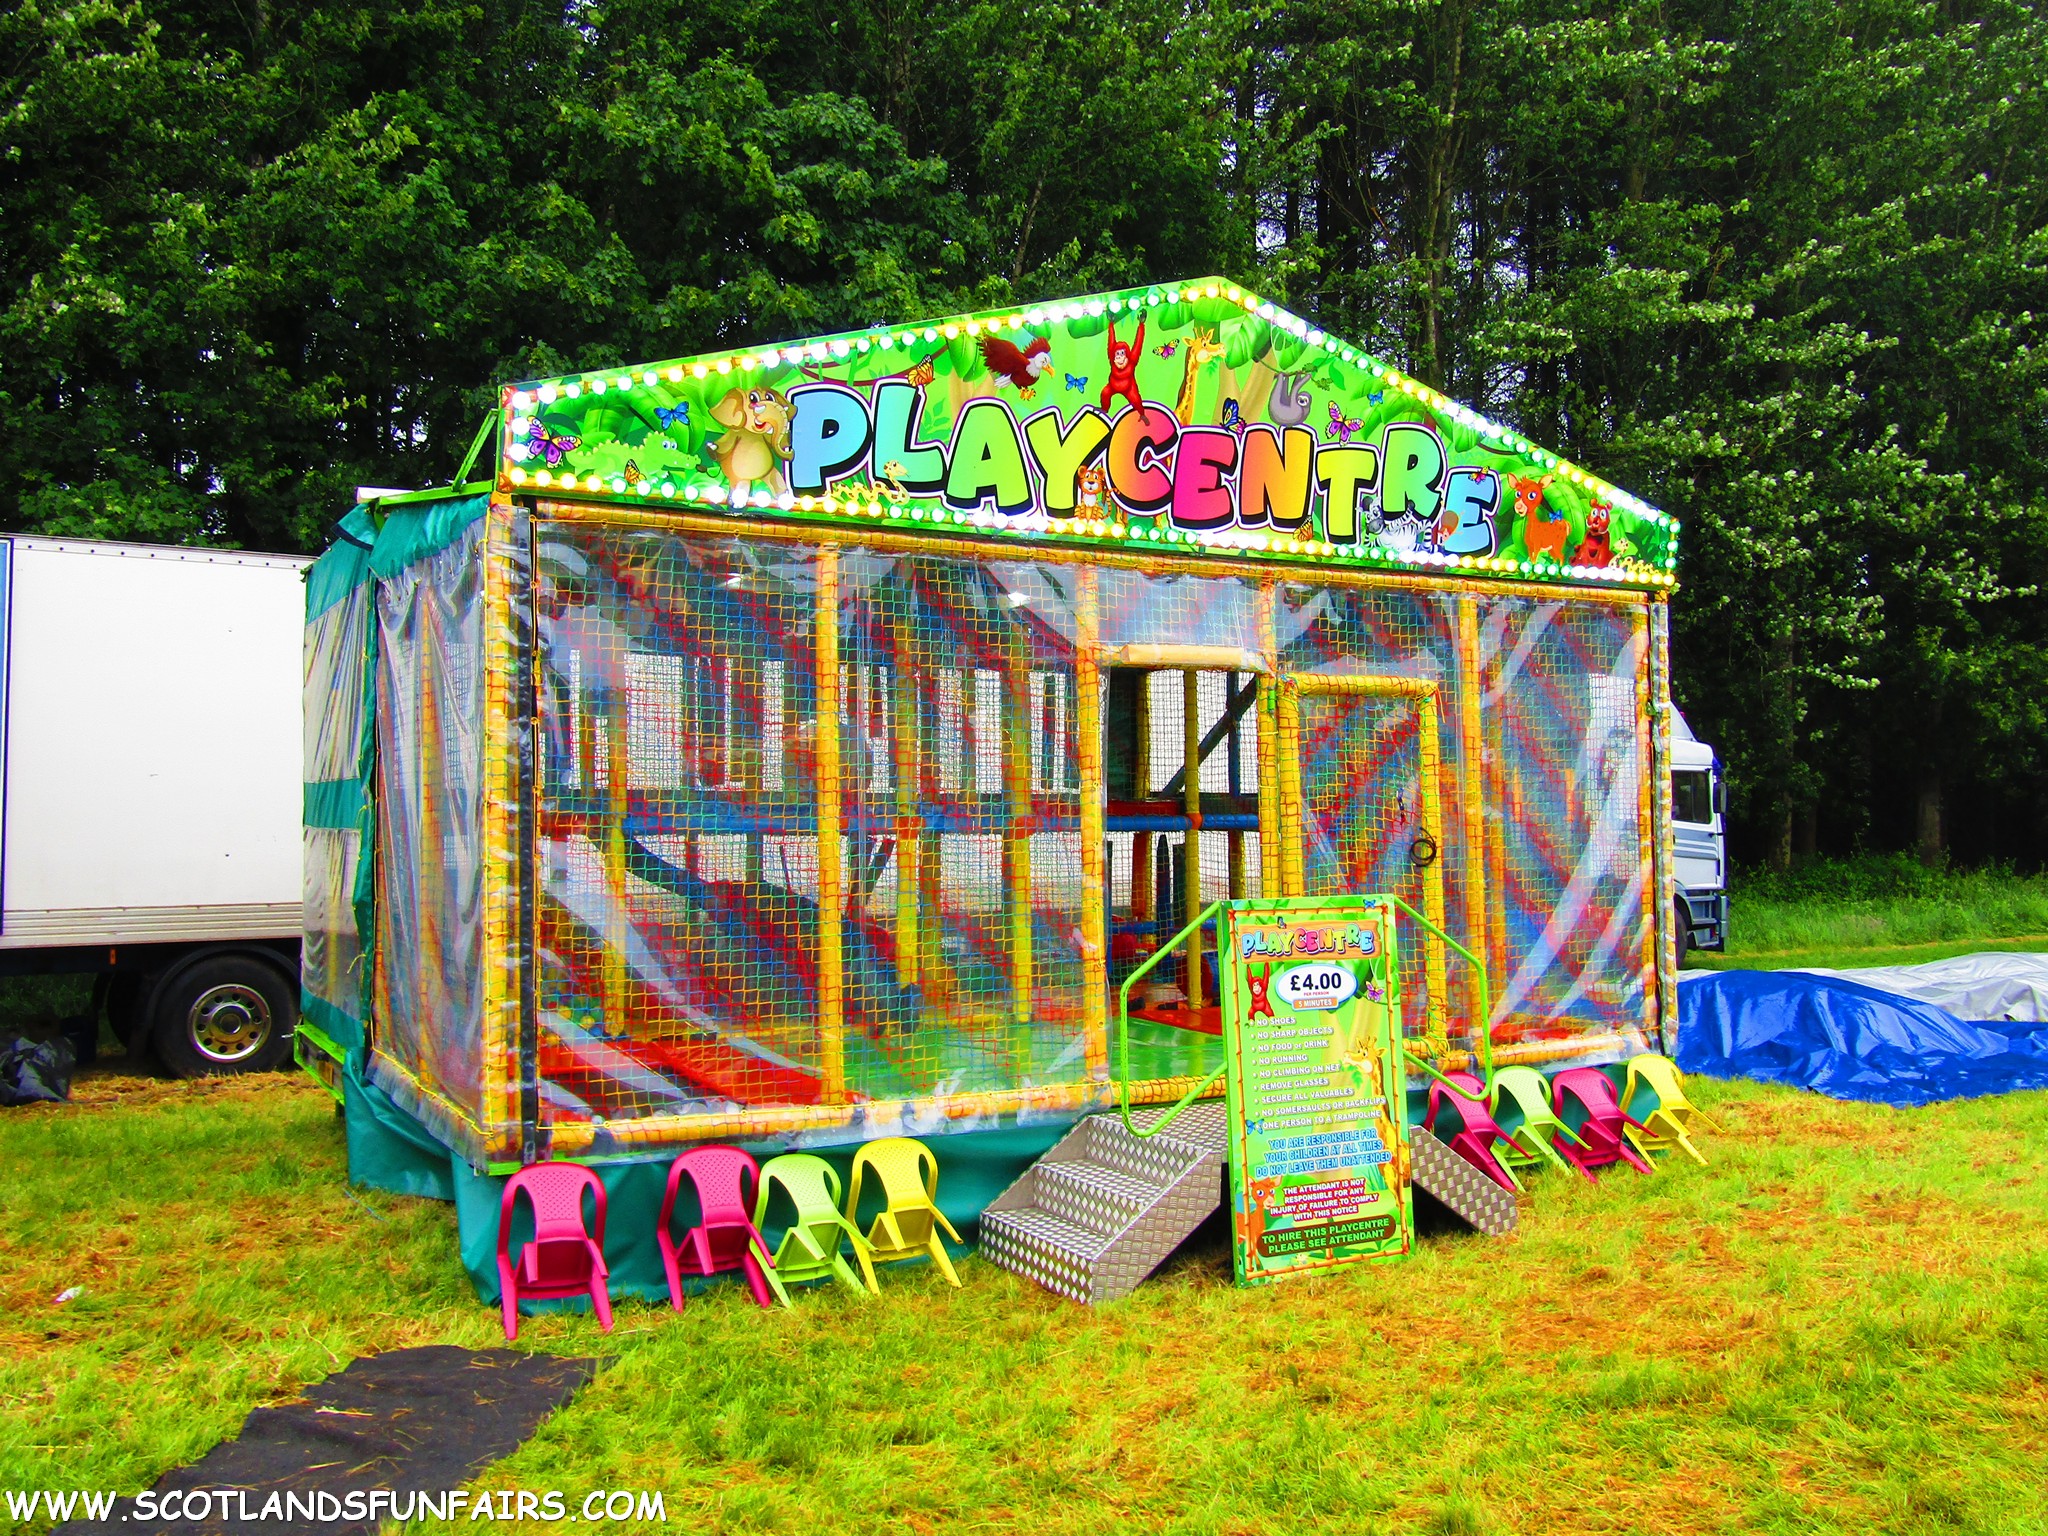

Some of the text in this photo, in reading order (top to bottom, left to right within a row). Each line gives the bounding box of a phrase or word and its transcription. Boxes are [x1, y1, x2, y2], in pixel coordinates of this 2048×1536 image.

[788, 380, 1499, 558] PLAYCENTRE
[1241, 923, 1374, 958] PLAYCENTRE
[1290, 972, 1341, 991] £4.00
[1304, 998, 1332, 1007] MINUTES
[1271, 1017, 1296, 1025] SHOES
[1271, 1030, 1296, 1038] SHARP
[1298, 1027, 1333, 1035] OBJECTS
[1304, 1040, 1329, 1048] DRINK
[1273, 1054, 1308, 1063] RUNNING
[1273, 1067, 1311, 1076] CLIMBING
[1261, 1078, 1329, 1091] REMOVE GLASSES
[1262, 1094, 1292, 1104] SECURE
[1311, 1088, 1353, 1098] VALUABLES
[1276, 1103, 1331, 1114] SOMERSAULTS
[1346, 1097, 1386, 1107] BACKFLIPS
[1263, 1121, 1279, 1129] ONE
[1282, 1118, 1312, 1127] PERSON
[1334, 1111, 1381, 1121] TRAMPOLINE
[1269, 1129, 1376, 1149] YOU ARE RESPONSIBLE FOR
[1264, 1140, 1382, 1163] YOUR CHILDREN AT ALL TIMES
[1256, 1152, 1391, 1177] DO NOT LEAVE THEM UNATTENDED
[1284, 1187, 1298, 1195] THE
[1299, 1182, 1340, 1193] ATTENDANT
[1285, 1191, 1332, 1204] RESPONSIBLE
[1350, 1187, 1364, 1195] ANY
[1271, 1206, 1296, 1214] INJURY
[1310, 1199, 1338, 1209] FAILURE
[1351, 1194, 1378, 1204] COMPLY
[1294, 1206, 1358, 1221] WITH THIS NOTICE
[1262, 1218, 1389, 1244] TO HIRE THIS PLAYCENTRE
[1269, 1229, 1384, 1253] PLEASE SEE ATTENDANT
